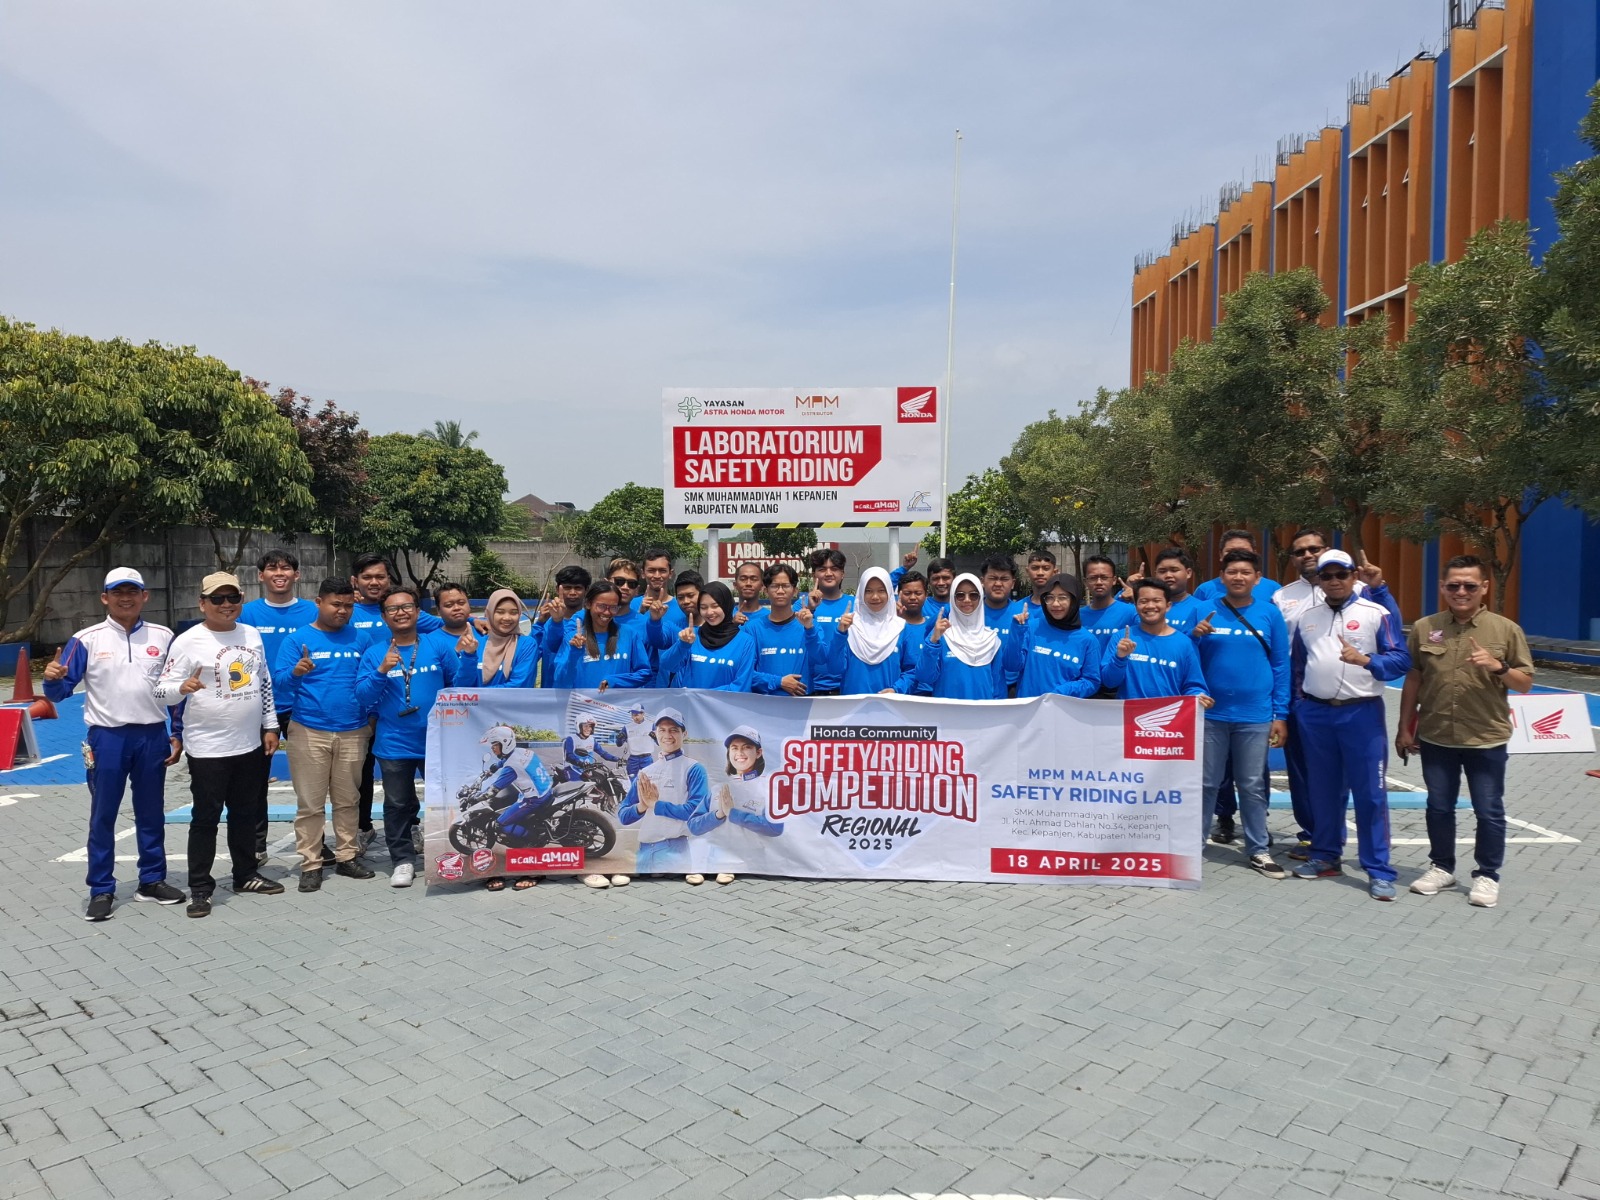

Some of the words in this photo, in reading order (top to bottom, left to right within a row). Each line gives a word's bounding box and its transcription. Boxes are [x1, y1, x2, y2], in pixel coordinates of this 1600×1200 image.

[795, 395, 839, 409] MPM
[703, 408, 729, 416] ASTRA
[730, 408, 757, 416] HONDA
[684, 430, 864, 456] LABORATORIUM
[684, 458, 772, 484] SAFETY
[777, 457, 854, 482] RIDING
[684, 491, 704, 502] SMK
[706, 491, 782, 502] MUHAMMADIYAH
[785, 491, 790, 501] 1
[792, 490, 838, 501] KEPANJEN
[684, 504, 738, 515] KABUPATEN
[741, 503, 779, 514] MALANG
[216, 645, 232, 660] RIDE
[437, 693, 479, 702] AHM
[435, 708, 469, 720] MPM
[813, 727, 856, 738] Honda
[859, 727, 936, 740] Community
[1134, 730, 1185, 738] HONDA
[1134, 746, 1153, 755] One
[787, 742, 872, 774] SAFETY
[880, 743, 962, 775] RIDING
[1028, 768, 1065, 781] MPM
[1071, 769, 1144, 784] MALANG
[772, 771, 974, 820] COMPETITION
[991, 784, 1064, 801] SAFETY
[1069, 787, 1137, 805] RIDING
[1142, 790, 1183, 805] LAB
[1014, 808, 1034, 816] SMK
[1036, 809, 1109, 821] Muhammadiyah
[1117, 813, 1159, 822] Kepanjen
[820, 814, 922, 838] REGIONAL
[1029, 819, 1062, 828] Ahmad
[1064, 820, 1096, 829] Dahlan
[1127, 823, 1171, 832] Kepanjen,
[1031, 829, 1075, 839] Kepanjen,
[1077, 831, 1126, 841] Kabupaten
[1128, 833, 1161, 841] Malang
[848, 838, 893, 850] 2025
[1007, 854, 1029, 868] 18
[1039, 856, 1101, 870] APRIL
[1111, 858, 1162, 872] 2025
